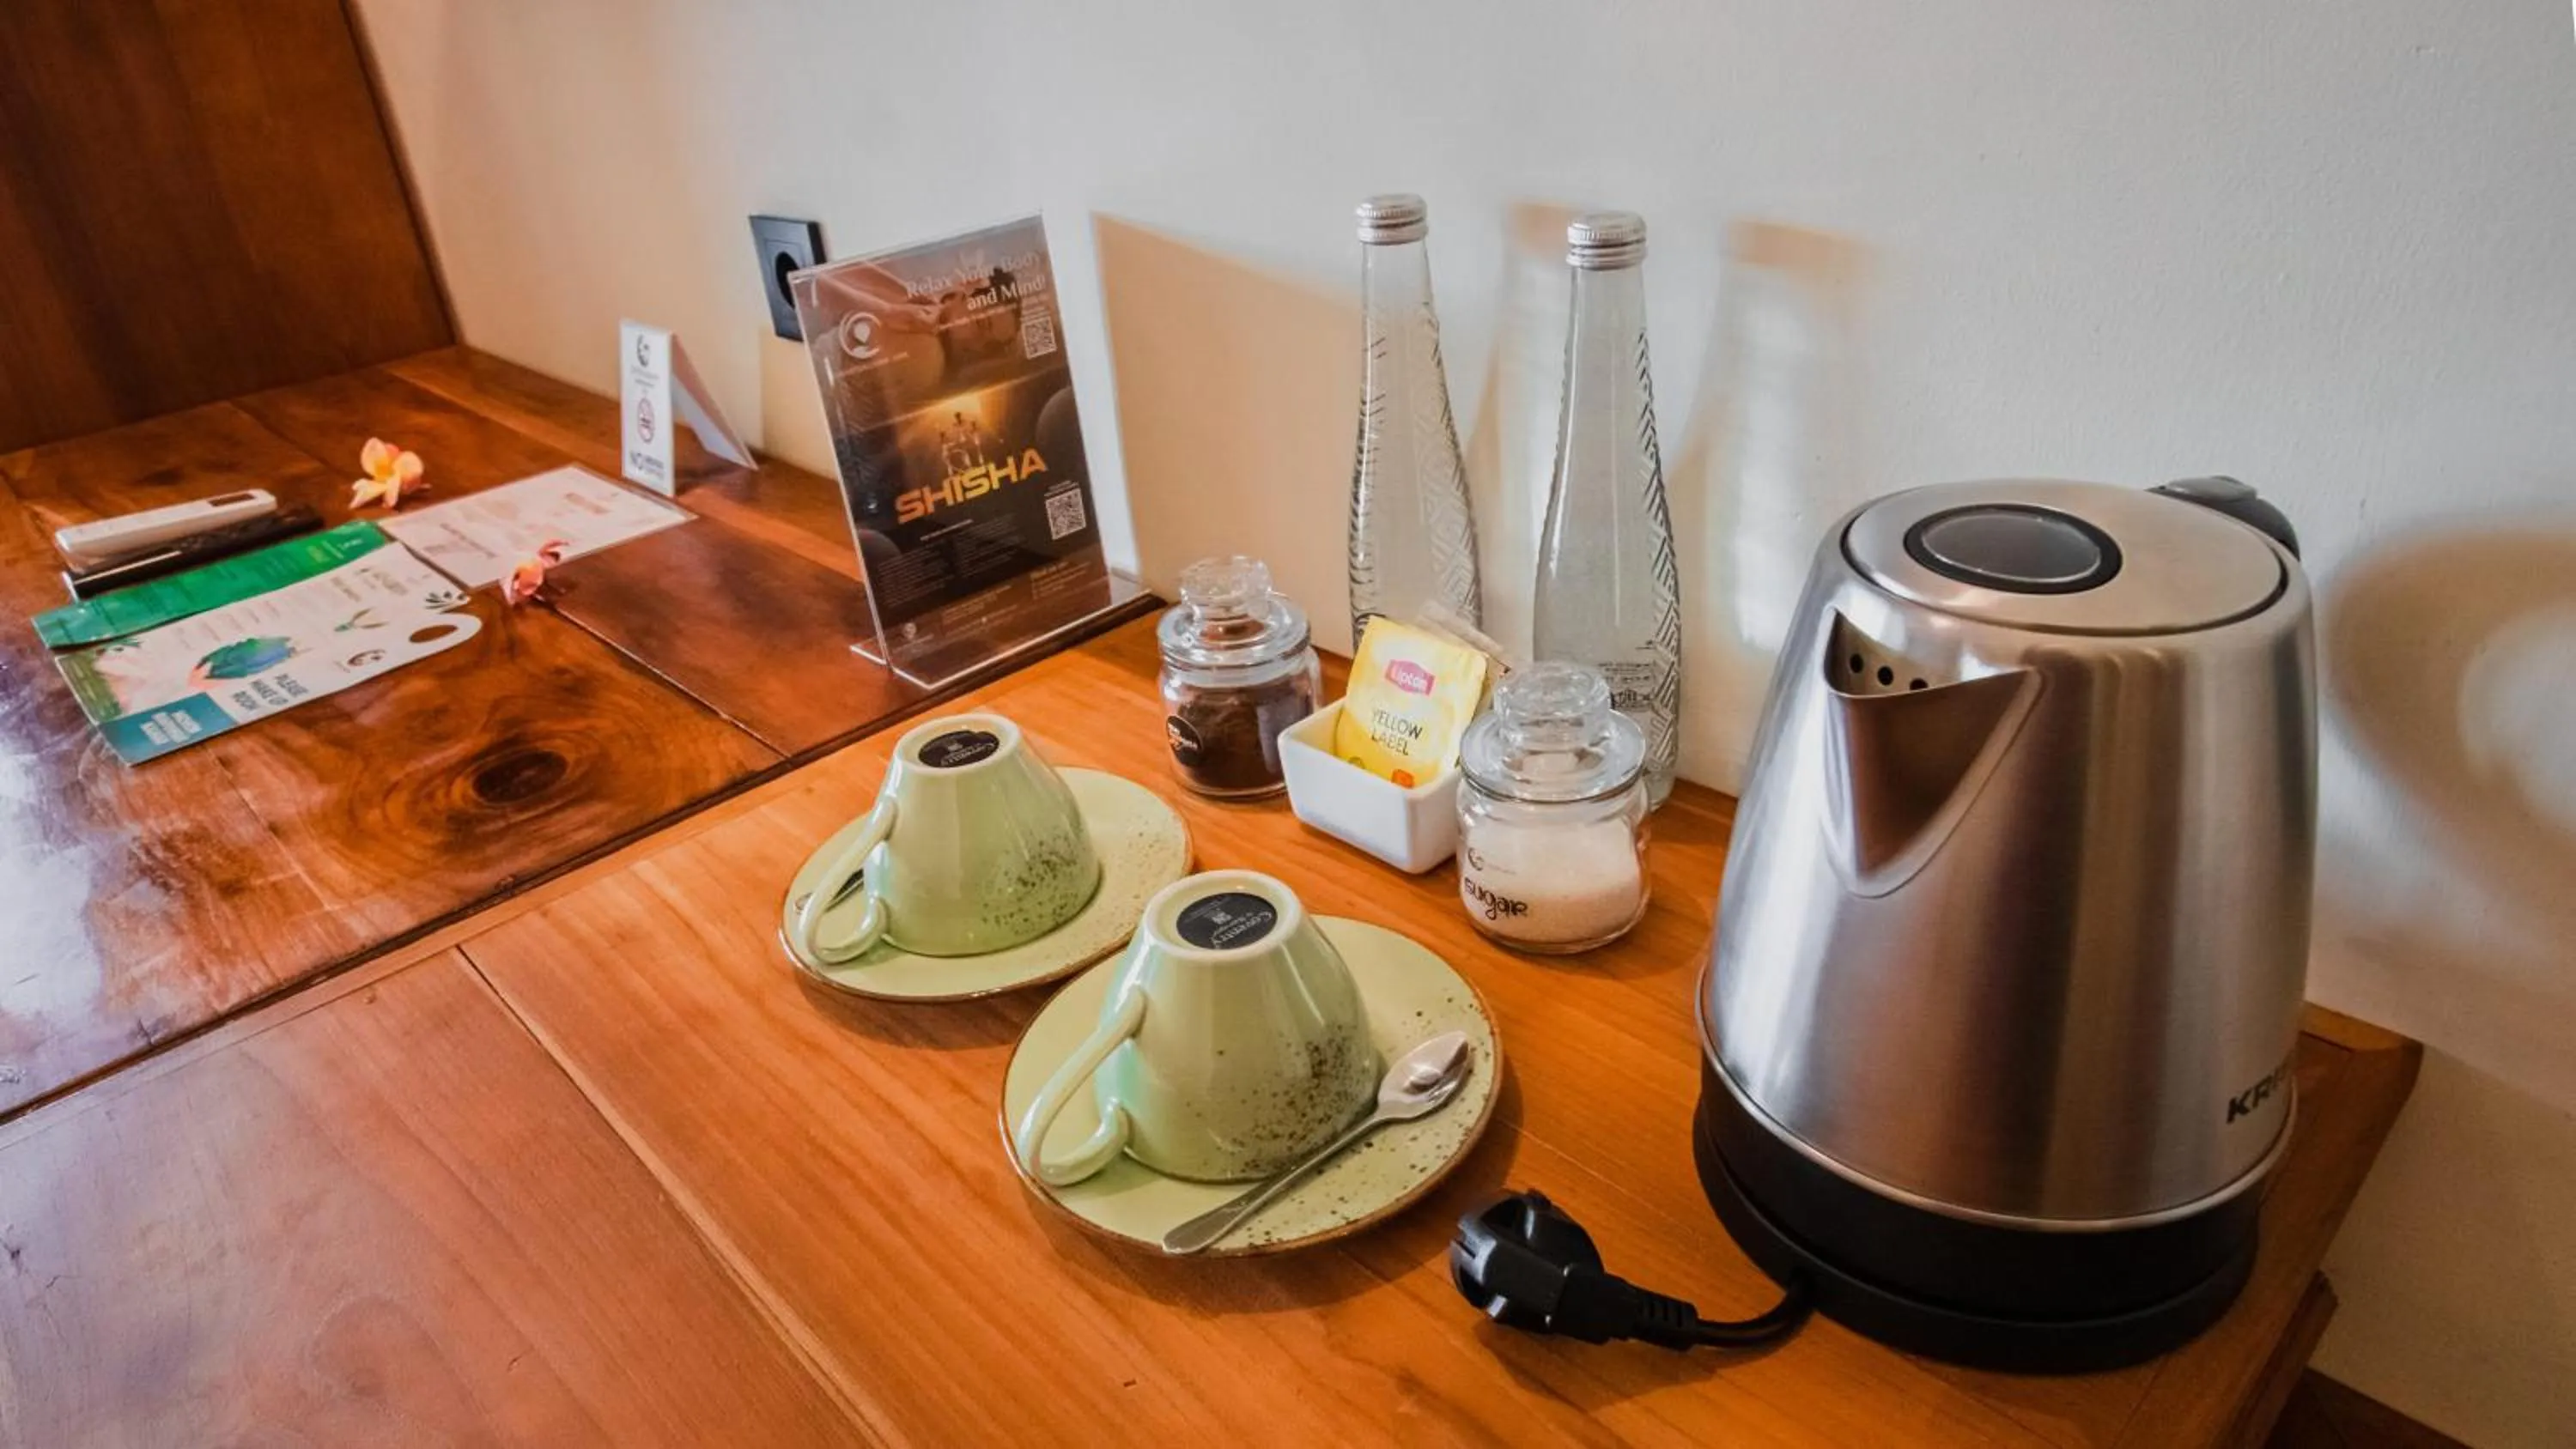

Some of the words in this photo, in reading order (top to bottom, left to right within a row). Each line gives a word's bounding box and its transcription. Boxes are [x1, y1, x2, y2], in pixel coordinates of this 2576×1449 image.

[907, 275, 954, 299] Relax
[955, 263, 994, 284] Your
[1000, 251, 1041, 274] Body
[966, 287, 998, 311] and
[895, 447, 1048, 524] SHISHA
[250, 679, 278, 700] MAKE
[274, 673, 309, 697] PLEASE
[1390, 665, 1428, 693] Lipton
[1374, 708, 1423, 740] YELLOW
[1372, 728, 1409, 756] LABEL
[1465, 876, 1528, 920] sugar
[1210, 911, 1273, 949] Coventry
